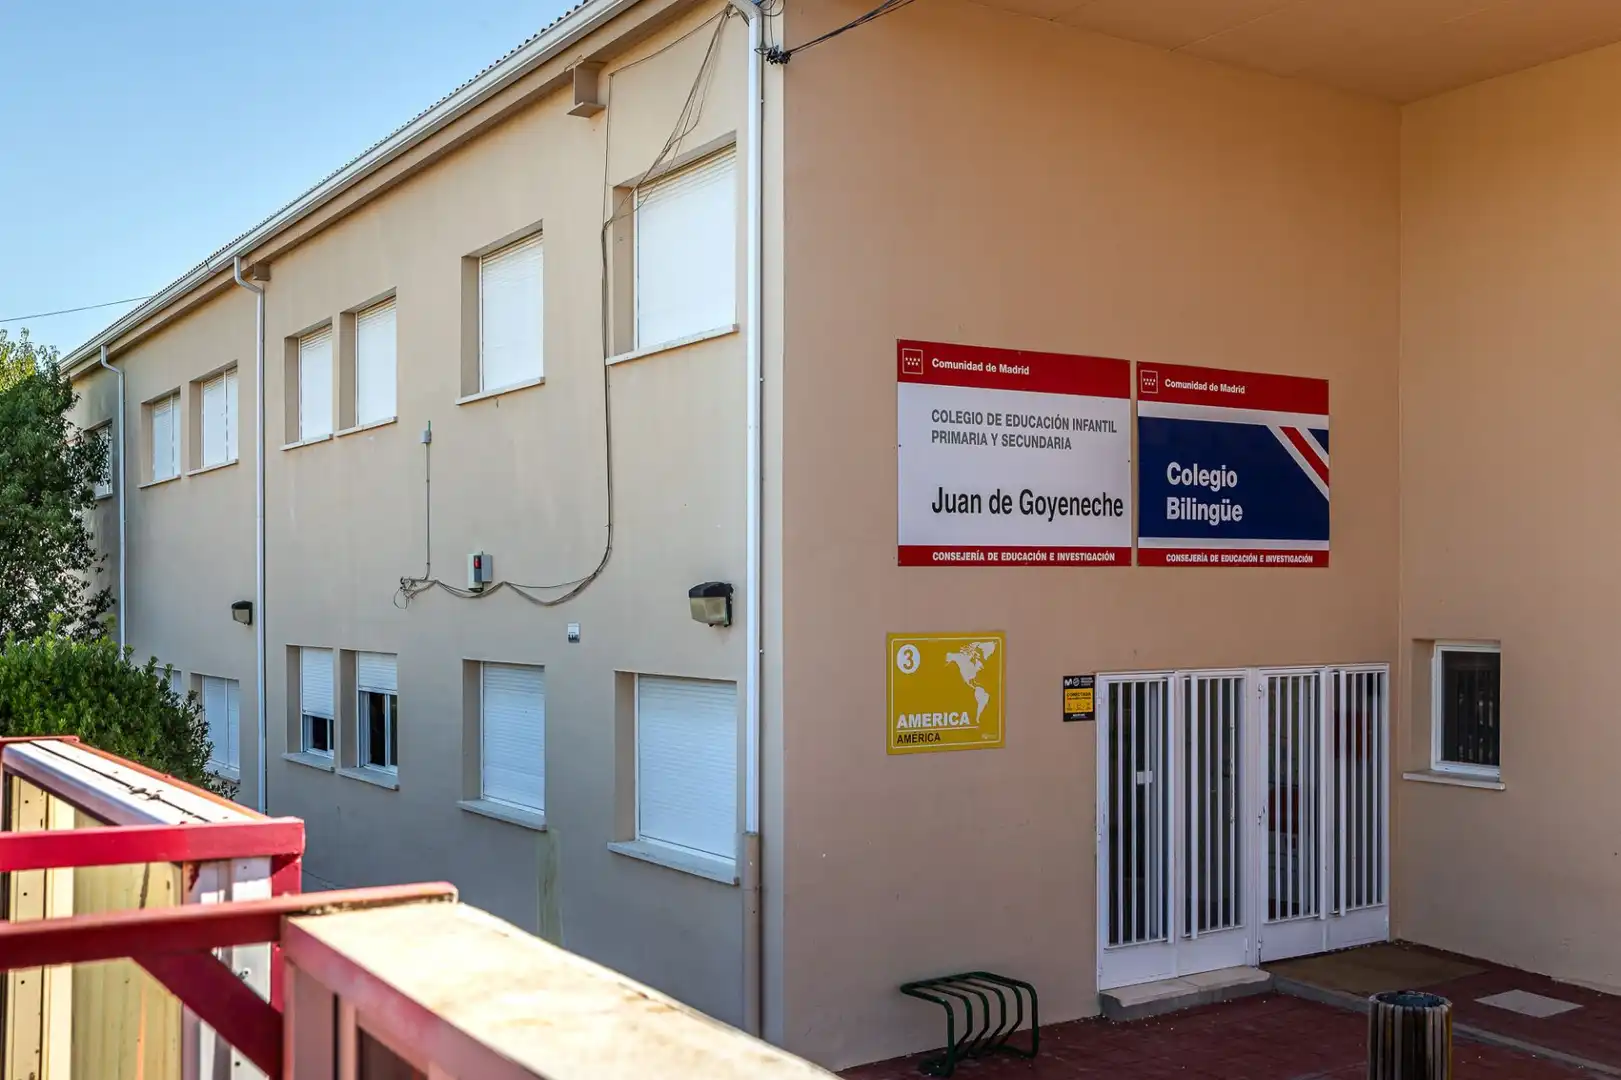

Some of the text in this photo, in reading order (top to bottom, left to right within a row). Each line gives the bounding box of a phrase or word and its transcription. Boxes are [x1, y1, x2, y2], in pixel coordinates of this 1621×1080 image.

[932, 358, 1030, 375] Comunidad de Madrid
[1164, 378, 1246, 394] Comunidad de Madrid
[932, 408, 1118, 433] COLEGIO DE EDUCACIÓN INFANTIL
[932, 430, 1072, 450] PRIMARIA Y SECUNDARIA
[1166, 461, 1238, 492] Colegio
[932, 486, 1124, 522] Juan de Goyeneche
[1166, 496, 1244, 526] Bilingüe
[932, 550, 1116, 562] CONSEJERÍA DE EDUCACIÓN E INVESTIGACIÓN
[1166, 552, 1314, 564] CONSEJERÍA DE EDUCACIÓN E INVESTIGACIÓN
[902, 648, 914, 670] 3
[896, 711, 970, 729] AMERICA
[896, 732, 942, 744] AMÉRICA
